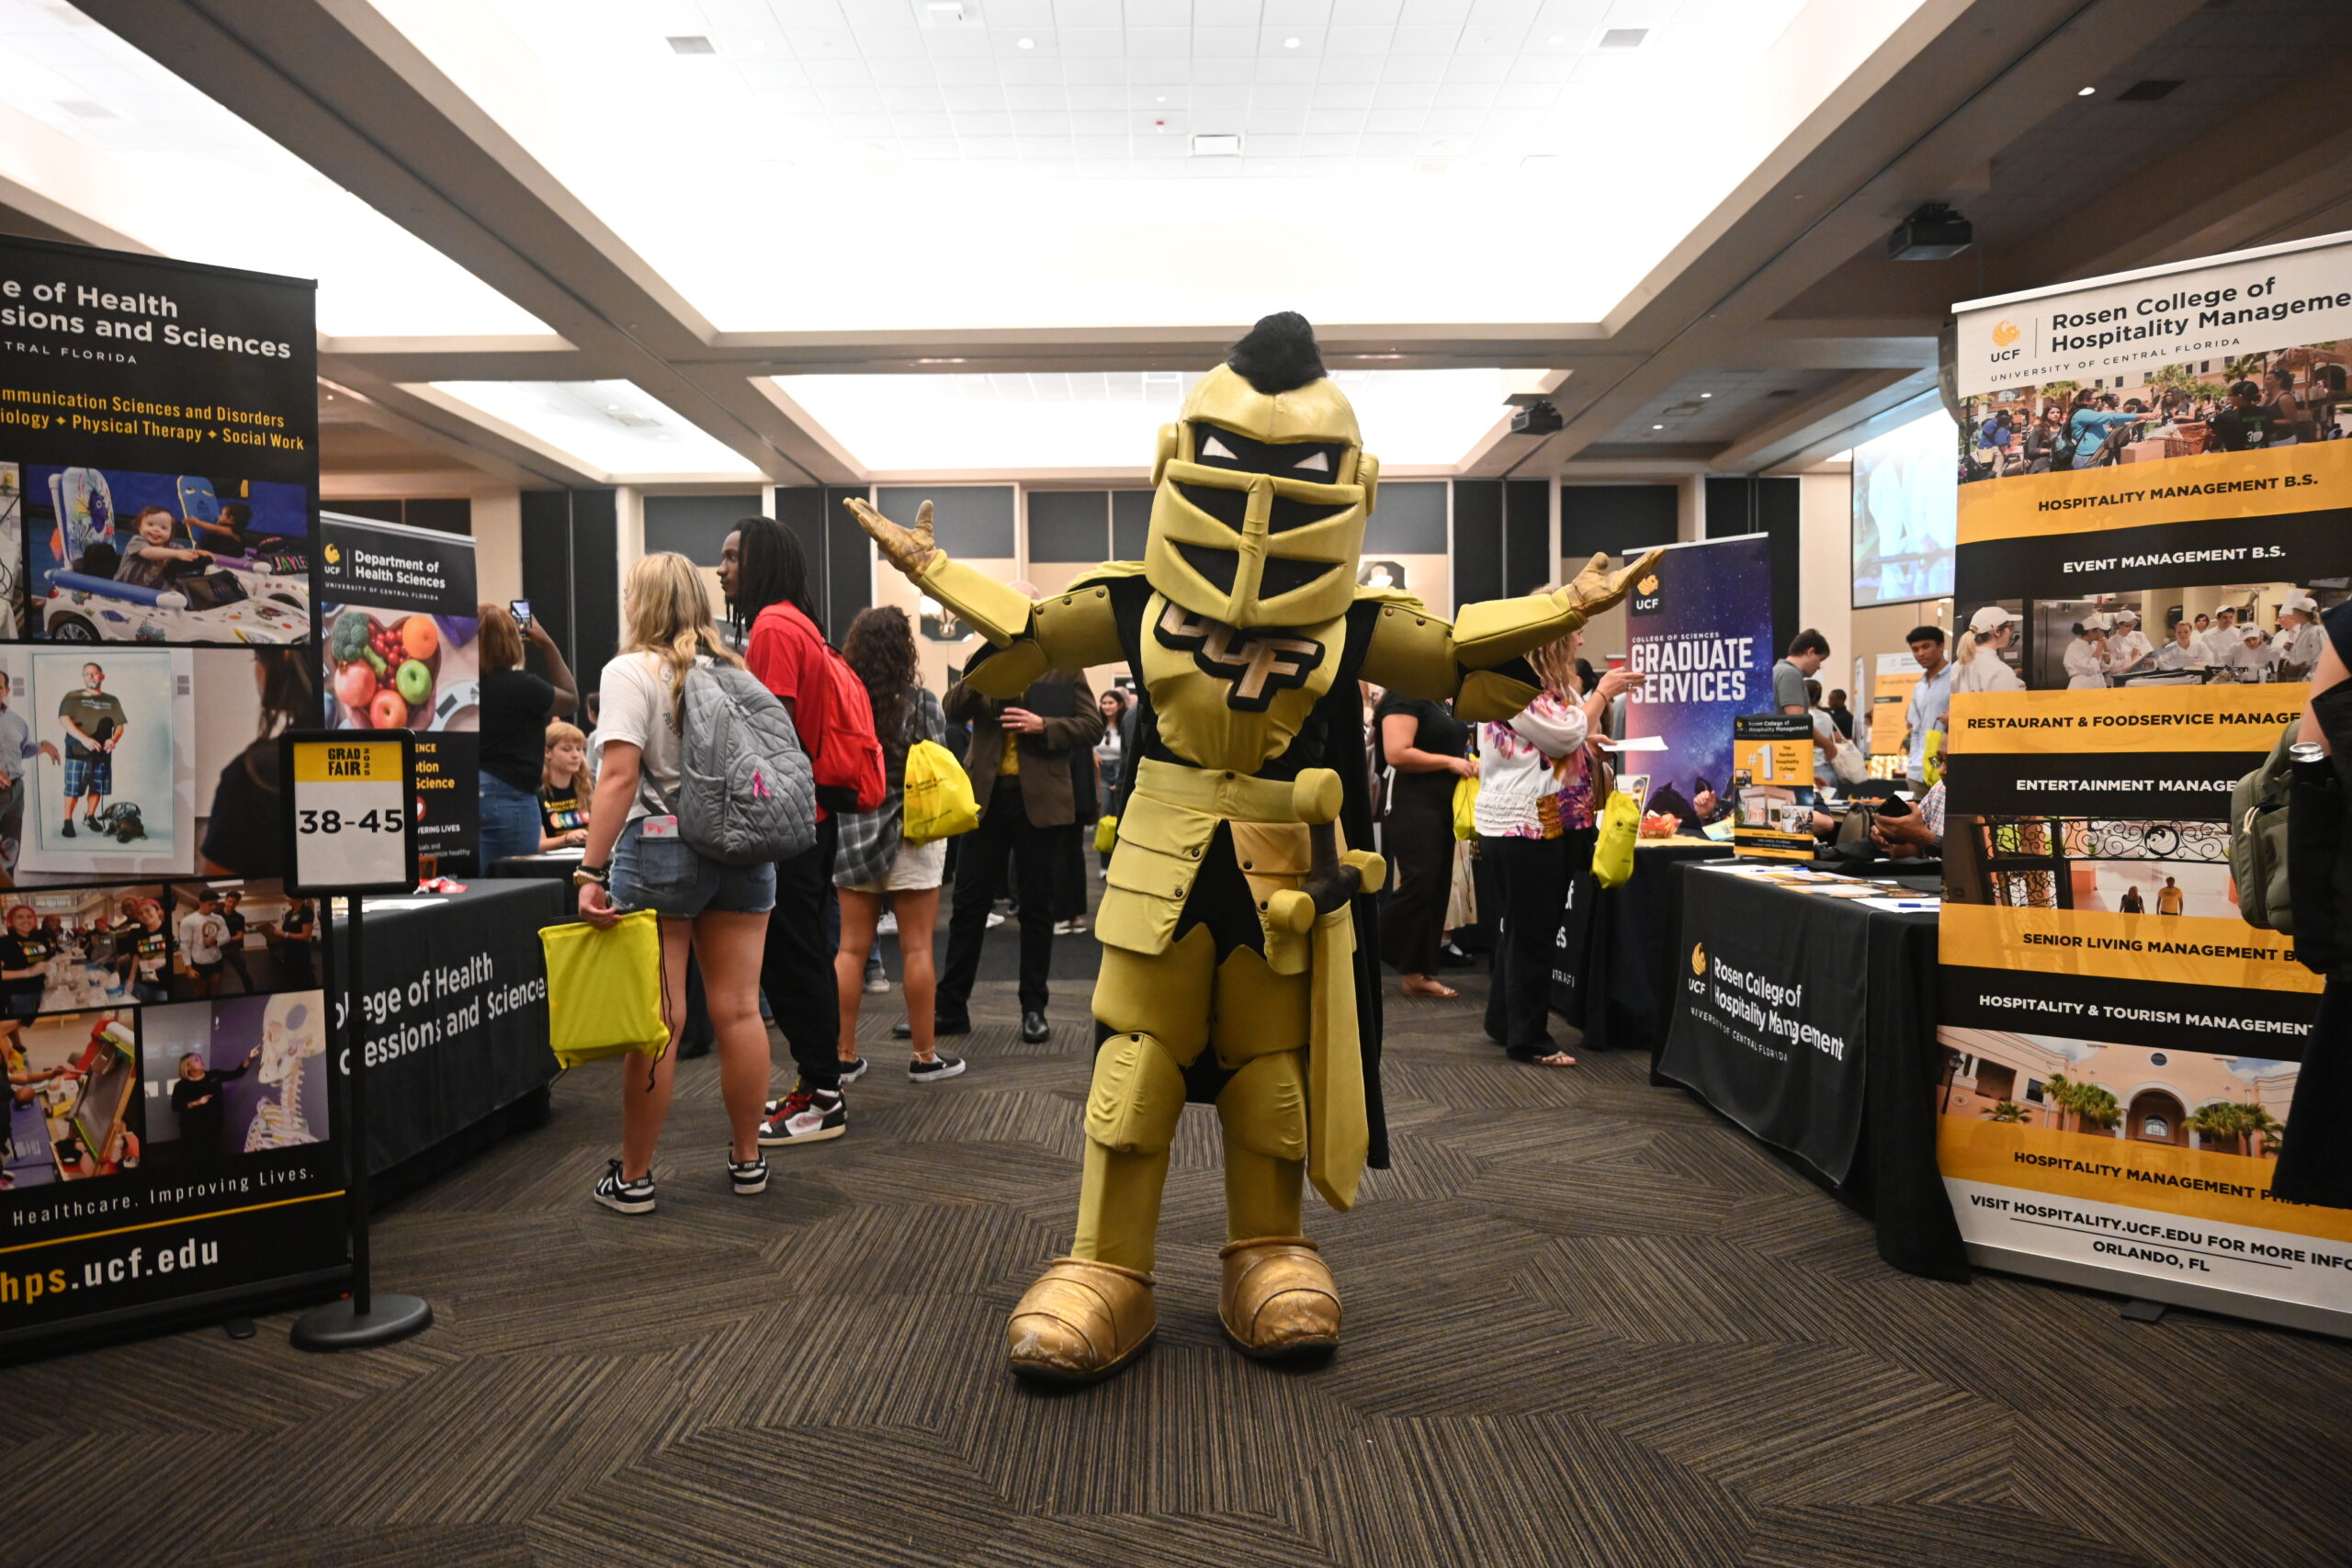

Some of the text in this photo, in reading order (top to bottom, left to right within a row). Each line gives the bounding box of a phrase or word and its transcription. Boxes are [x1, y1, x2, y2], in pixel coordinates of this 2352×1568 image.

[33, 281, 66, 303] of
[77, 285, 178, 319] Health
[2052, 276, 2277, 332] Rosen College of
[1, 305, 291, 359] sions and Sciences
[2051, 292, 2351, 353] Hospitality Manageme
[5, 341, 137, 365] TRAL FLORIDA
[1991, 349, 2020, 363] UCF
[1991, 337, 2241, 382] UNIVERSITY OF CENTRAL FLORIDA
[2, 389, 285, 428] mmunication Sciences and Disorders
[1, 407, 304, 450] iology Physical Therapy Social Work
[2038, 473, 2318, 512] HOSPITALITY MANAGEMENT B.S.
[324, 565, 341, 575] UCF
[355, 549, 440, 573] Department of
[2063, 545, 2286, 573] EVENT MANAGEMENT B.S.
[325, 581, 367, 592] UNIVERSITY
[379, 588, 409, 598] CENTRAL
[412, 592, 438, 601] FLORIDA
[356, 566, 447, 589] Health Sciences
[1636, 598, 1659, 610] UCF
[1632, 635, 1664, 643] COLLEGE
[1680, 631, 1720, 640] SCIENCES
[1631, 637, 1754, 673] GRADUATE
[1631, 670, 1747, 704] SERVICES
[1967, 716, 2074, 729] RESTAURANT
[2077, 716, 2088, 728] &
[2093, 713, 2214, 726] FOODSERVICE
[328, 748, 360, 760] GRAD
[328, 761, 361, 776] FAIR
[416, 761, 439, 773] tion
[1748, 743, 1773, 781] #1
[416, 778, 455, 790] Science
[2016, 779, 2237, 792] ENTERTAINMENT MANAGE
[300, 808, 403, 834] 38-45
[441, 824, 460, 834] LIVES
[2023, 932, 2083, 947] SENIOR
[2086, 937, 2143, 952] LIVING
[2147, 942, 2278, 961] MANAGEMENT
[408, 970, 431, 1008] of
[435, 952, 493, 998] Health
[1689, 978, 1706, 995] UCF
[1714, 956, 1744, 989] Rosen
[1785, 984, 1802, 1008] of
[447, 996, 480, 1037] and
[487, 977, 548, 1021] Science
[1714, 984, 1766, 1032] Hospitality
[1979, 995, 2313, 1036] HOSPITALITY & TOURISM MANAGEMEN
[1733, 1030, 1758, 1051] CENTRAL
[1758, 1043, 1788, 1062] FLORIDA
[2014, 1151, 2121, 1178] HOSPITALITY
[2126, 1168, 2256, 1199] MANAGEMENT
[14, 1166, 315, 1226] Healthcare. Improving Lives.
[1971, 1195, 2010, 1212] VISIT
[2014, 1202, 2202, 1245] HOSPITALITY.UCF.EDU
[2208, 1235, 2245, 1252] FOR
[2251, 1243, 2305, 1262] MORE
[1, 1238, 219, 1304] hps.ucf.edu
[2093, 1240, 2211, 1271] ORLANDO, FL
